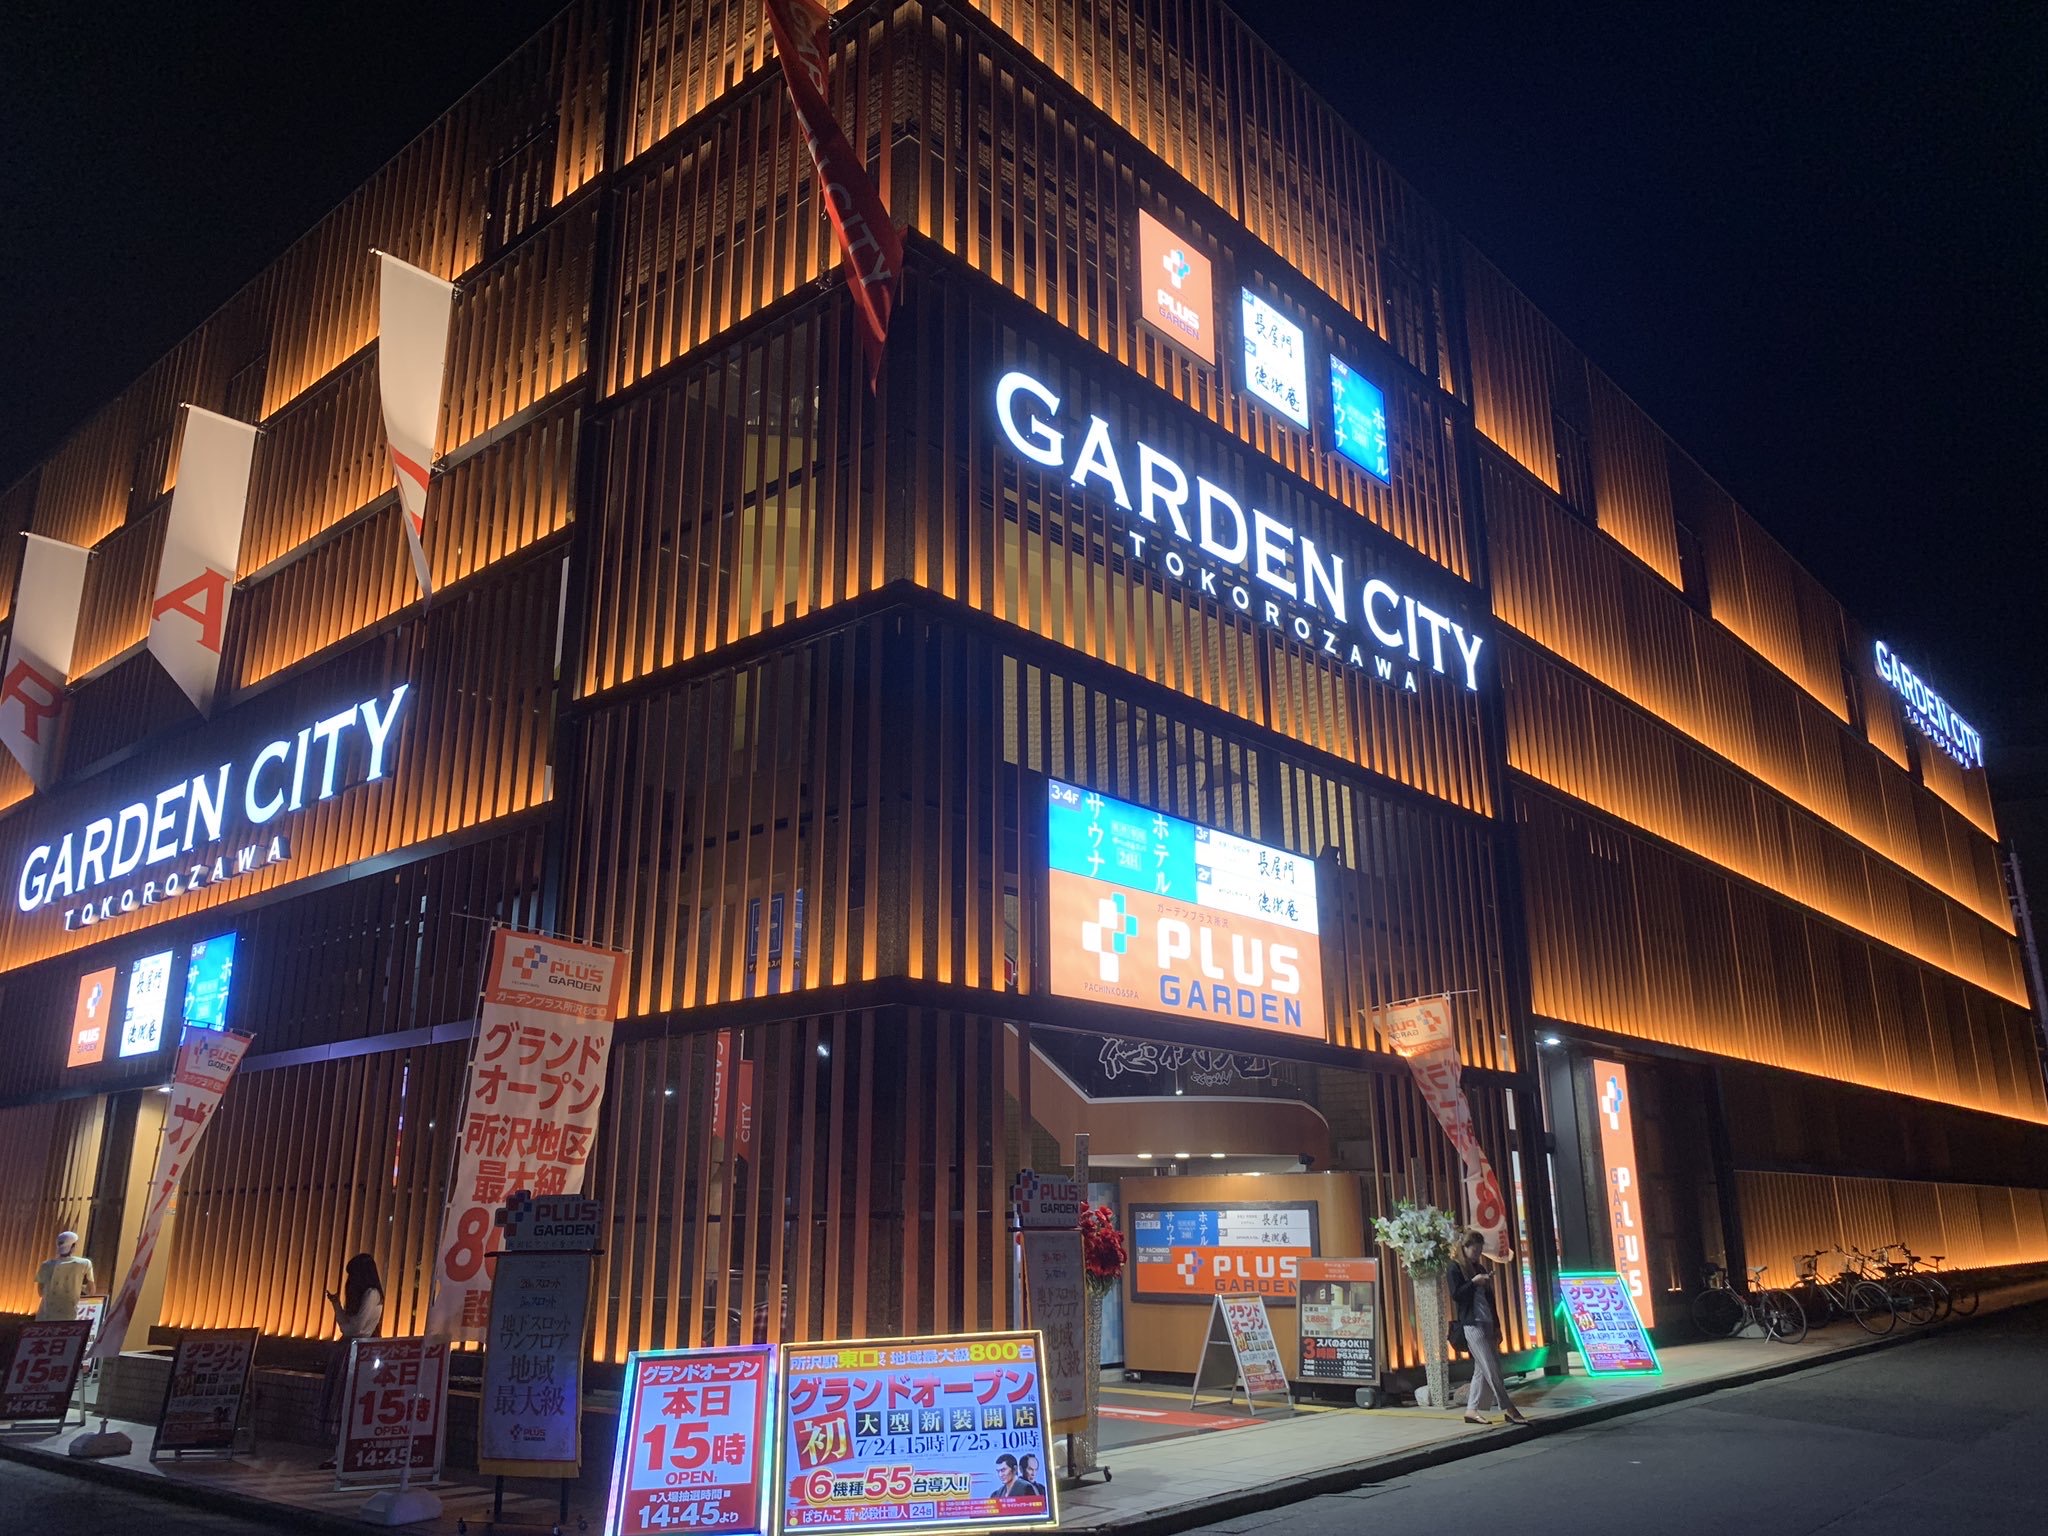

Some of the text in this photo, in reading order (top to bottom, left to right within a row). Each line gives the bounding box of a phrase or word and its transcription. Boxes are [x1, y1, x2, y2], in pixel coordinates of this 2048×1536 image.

[1157, 288, 1200, 330] PLUS
[1159, 306, 1200, 340] GARDEN
[1331, 377, 1348, 447] サウナ
[1371, 407, 1389, 477] ホテル
[996, 371, 1484, 692] GARDEN CITY
[152, 566, 231, 655] A
[1129, 530, 1417, 693] TOKOROZAWA
[1875, 640, 1982, 768] GARDEN CITY
[18, 683, 410, 913] GARDEN CITY
[1086, 792, 1105, 877] サウナ
[1153, 813, 1172, 894] ホテル
[1258, 851, 1296, 885] 長屋門
[64, 836, 281, 931] TOKOROZAWA
[550, 960, 604, 984] PLUS
[1157, 917, 1300, 995] PLUS
[548, 975, 602, 993] GARDEN
[1160, 975, 1302, 1028] GARDEN
[484, 1021, 605, 1076] グランド
[475, 1064, 600, 1115] オープン
[464, 1113, 593, 1166] 所沢地区
[741, 1102, 752, 1143] CITY
[472, 1159, 568, 1204] 最大級
[1039, 1183, 1079, 1201] PLUS
[535, 1203, 598, 1222] PLUS
[1040, 1202, 1079, 1214] GARDEN
[533, 1224, 596, 1237] GARDEN
[1165, 1211, 1175, 1246] サウナ
[1198, 1211, 1209, 1246] ホテル
[1617, 1167, 1643, 1297] PLUS
[1213, 1255, 1297, 1278] PLUS
[1214, 1279, 1297, 1293] GARDEN
[1568, 1287, 1619, 1300] グランド
[1228, 1304, 1261, 1318] グランド
[1573, 1298, 1624, 1312] オープン
[1231, 1316, 1265, 1331] オープン
[28, 1338, 68, 1356] 本日
[186, 1341, 243, 1358] グランド
[500, 1333, 570, 1351] ワンフロア
[14, 1358, 70, 1384] 15時
[372, 1362, 419, 1387] 本日
[508, 1354, 556, 1385] 地域
[643, 1361, 760, 1385] グランドオープン
[358, 1389, 431, 1426] 15時
[494, 1385, 566, 1417] 最大級
[661, 1385, 731, 1420] 本日
[789, 1367, 1036, 1415] グランドオープン
[374, 1425, 408, 1436] OPEN
[523, 1429, 546, 1437] PLUS
[858, 1406, 1035, 1435] 大型新装開店
[642, 1421, 746, 1471] 15時
[800, 1416, 847, 1466] 初
[665, 1470, 714, 1486] OPEN
[808, 1465, 968, 1501] 6機種55台導入!!
[638, 1501, 739, 1529] 14:45より
[803, 1508, 842, 1523] ぱちんこ
